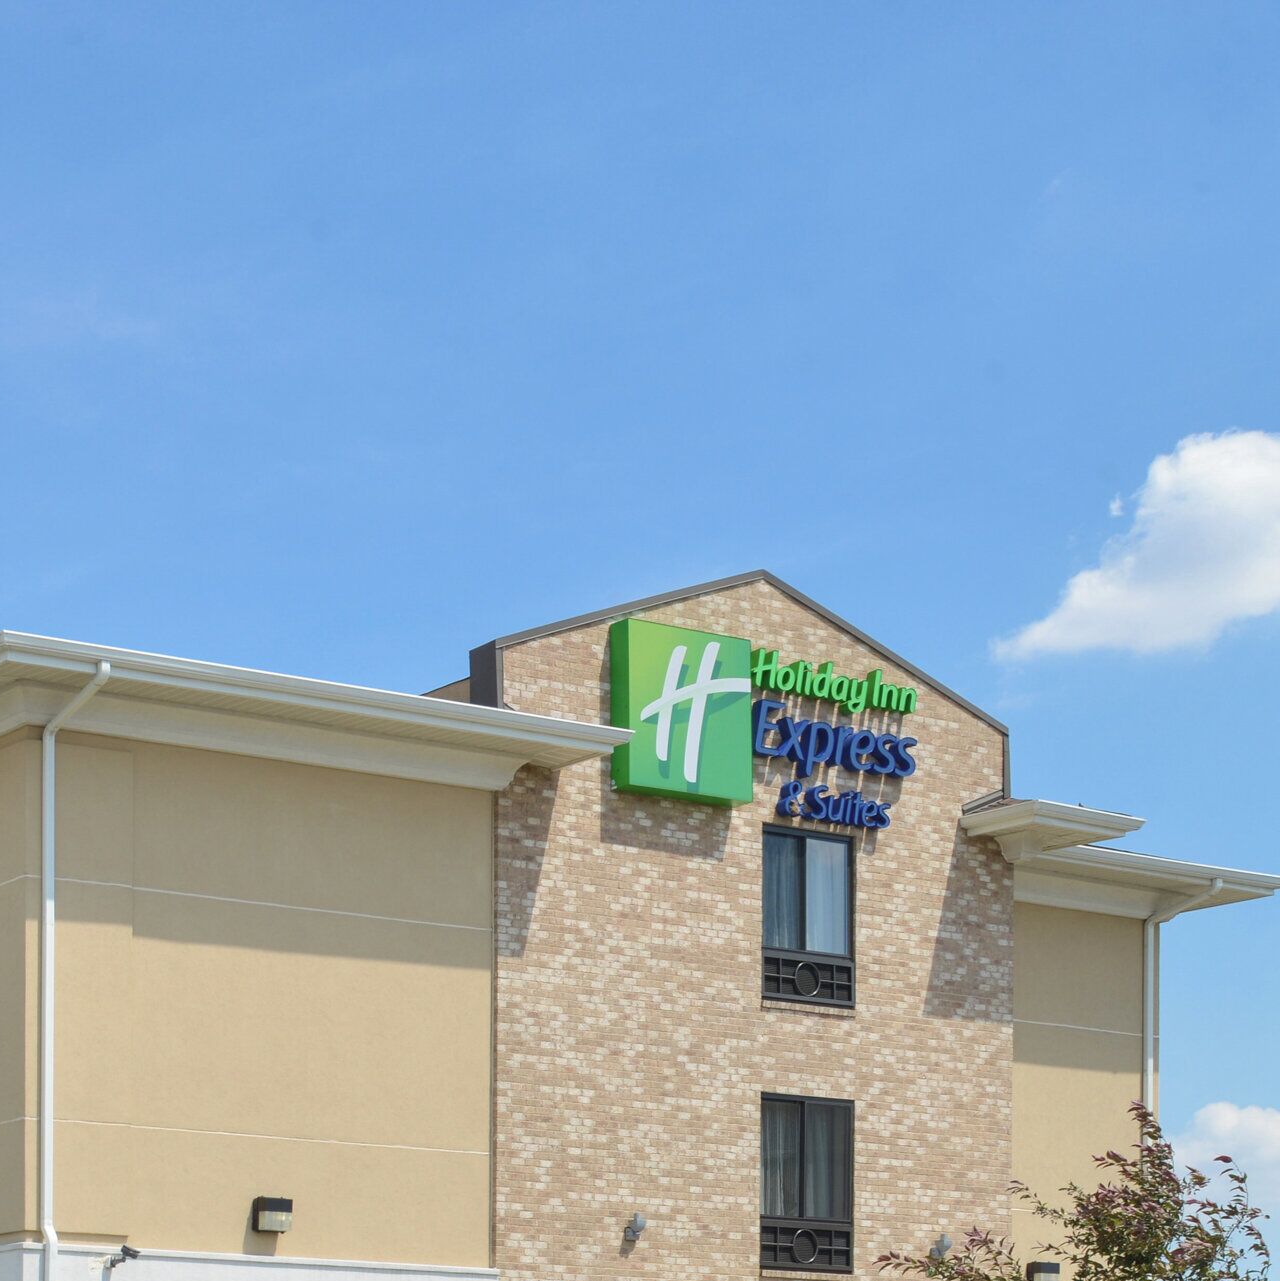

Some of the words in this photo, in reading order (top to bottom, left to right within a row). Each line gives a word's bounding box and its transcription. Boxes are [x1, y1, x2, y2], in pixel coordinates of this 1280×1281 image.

[751, 648, 869, 713] Holiday
[866, 669, 918, 714] Inn
[752, 699, 918, 778] Express
[776, 780, 806, 817] &
[805, 784, 892, 829] Suites
